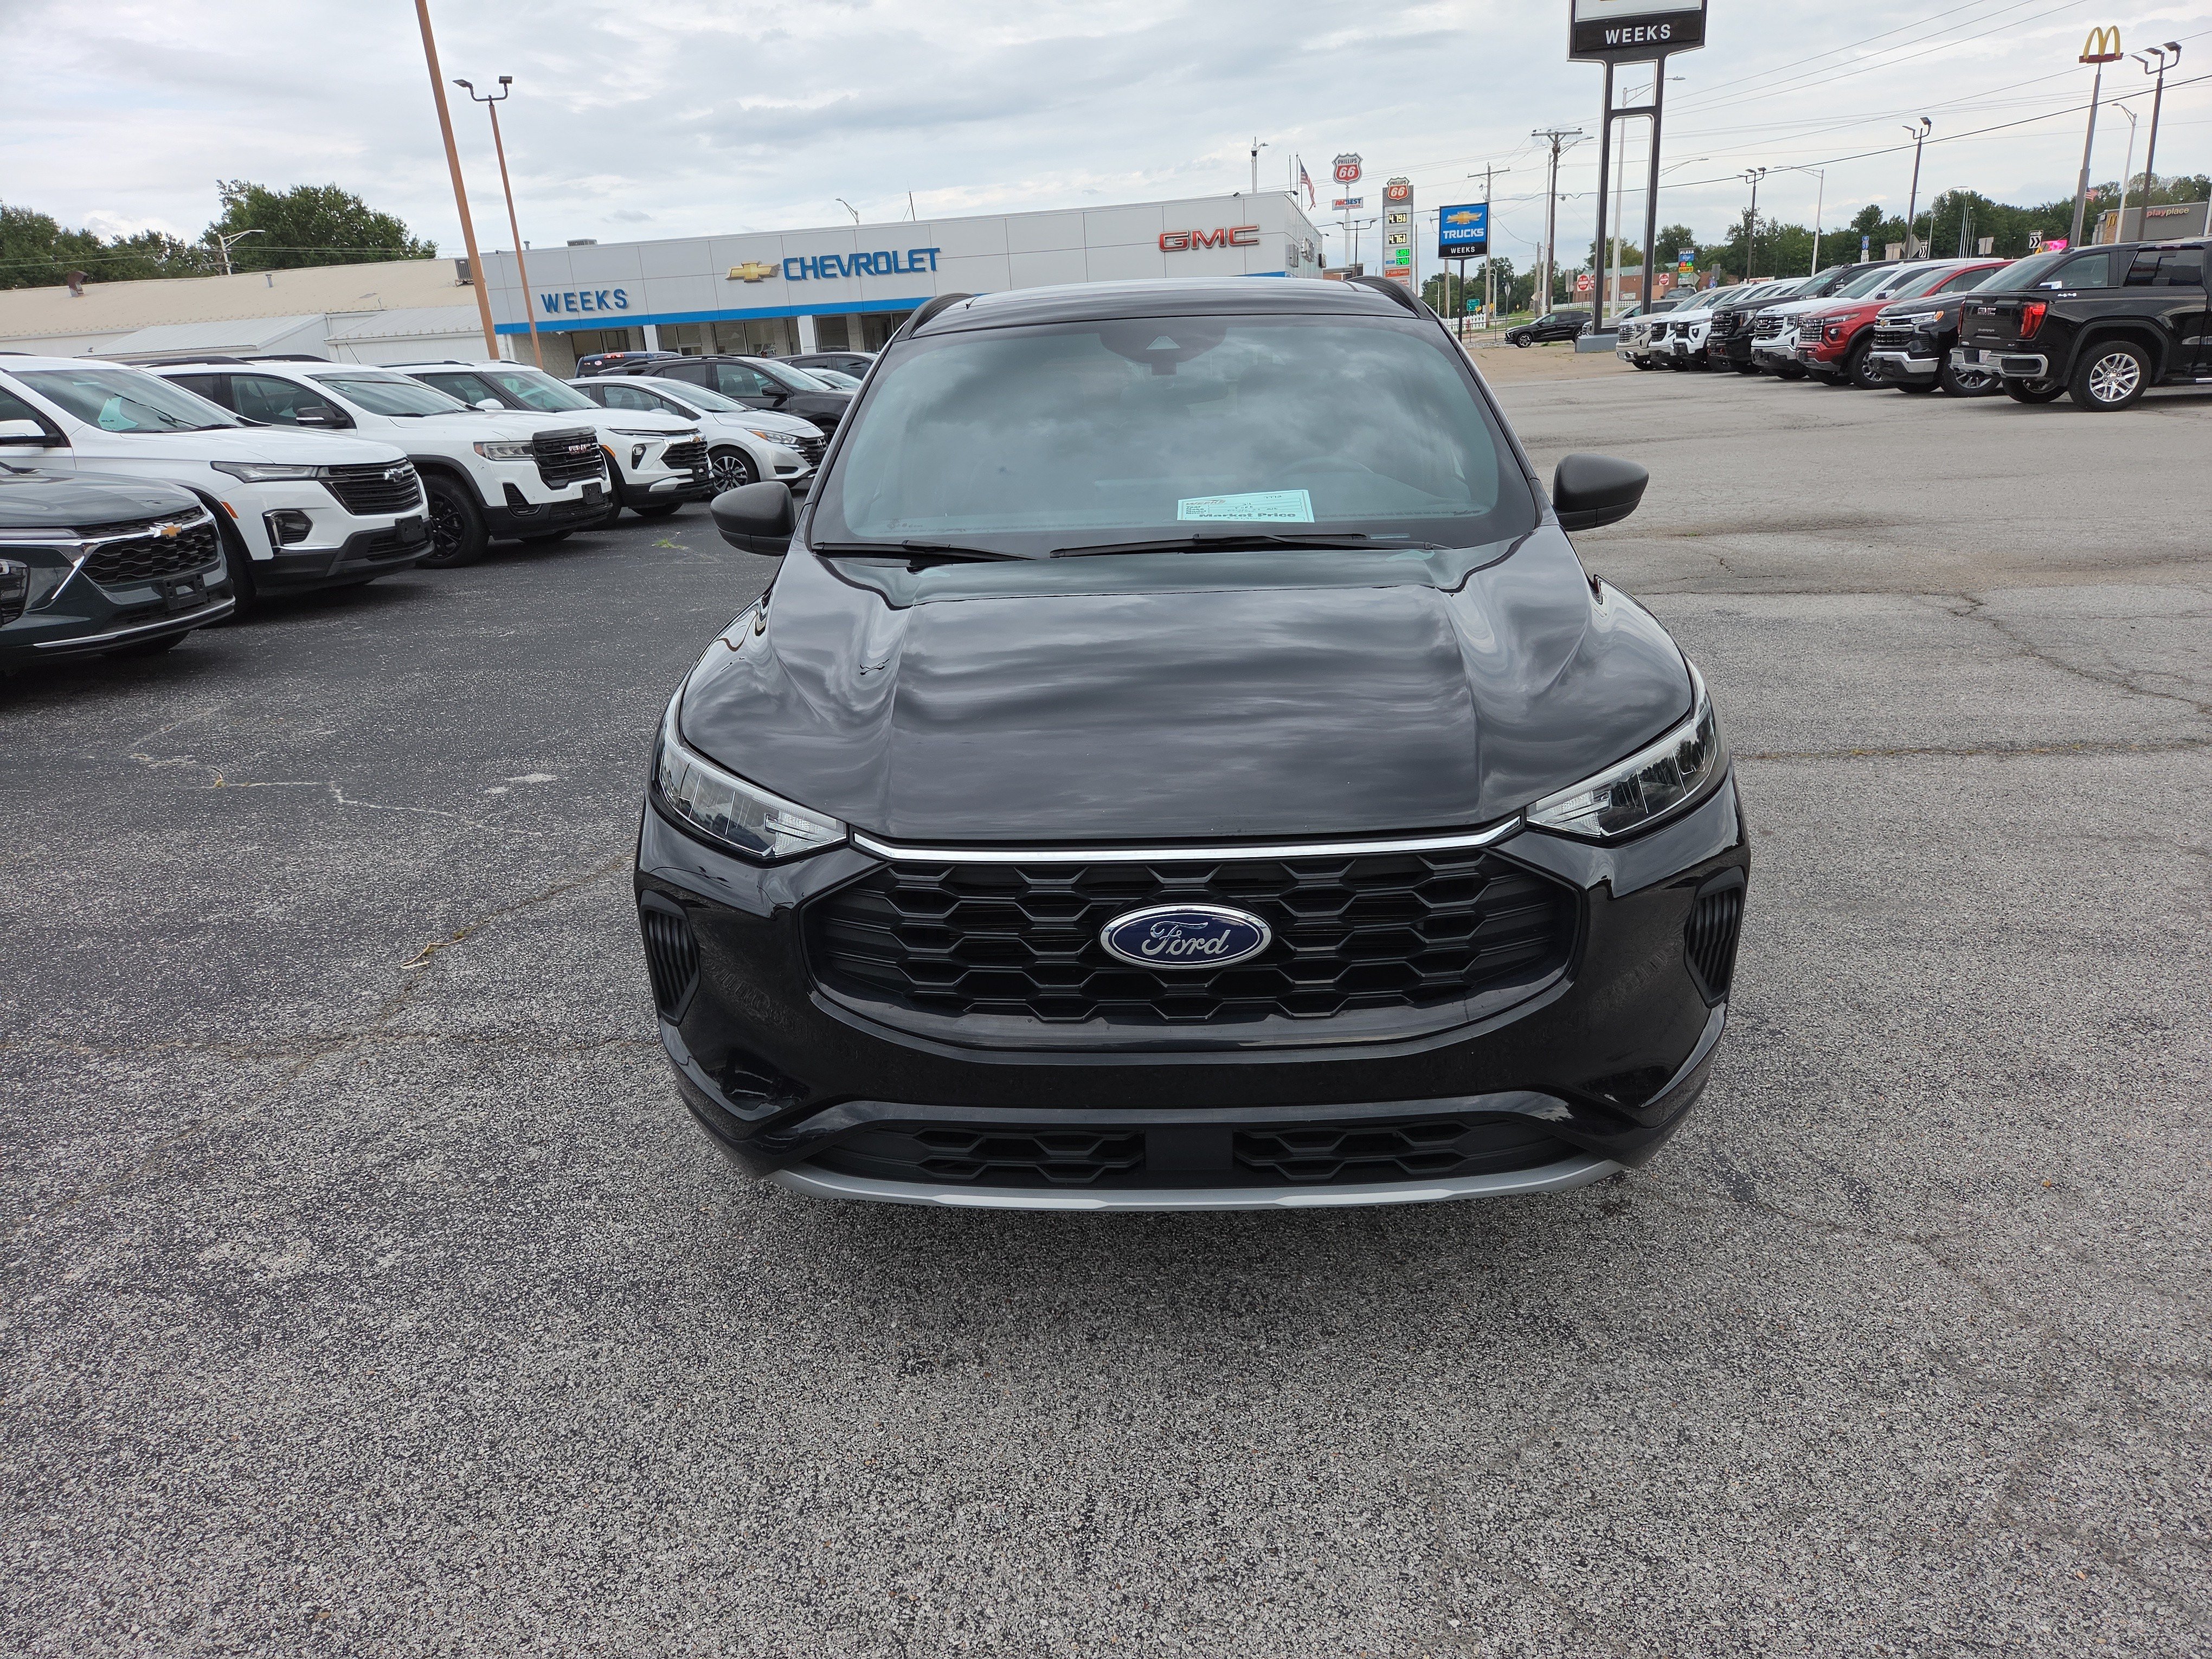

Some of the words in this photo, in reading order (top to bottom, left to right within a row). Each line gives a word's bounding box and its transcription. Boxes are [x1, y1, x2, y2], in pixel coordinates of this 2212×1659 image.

[1605, 24, 1671, 44] WEEKS
[1339, 166, 1356, 178] 66
[1391, 187, 1405, 197] 66
[2146, 207, 2190, 218] playplace
[1158, 223, 1260, 252] GMC
[1443, 228, 1484, 239] TRUCKS
[1450, 246, 1476, 254] WEEKS
[783, 247, 941, 281] CHEVROLET
[541, 288, 629, 313] WEEKS
[1141, 921, 1231, 956] Ford
